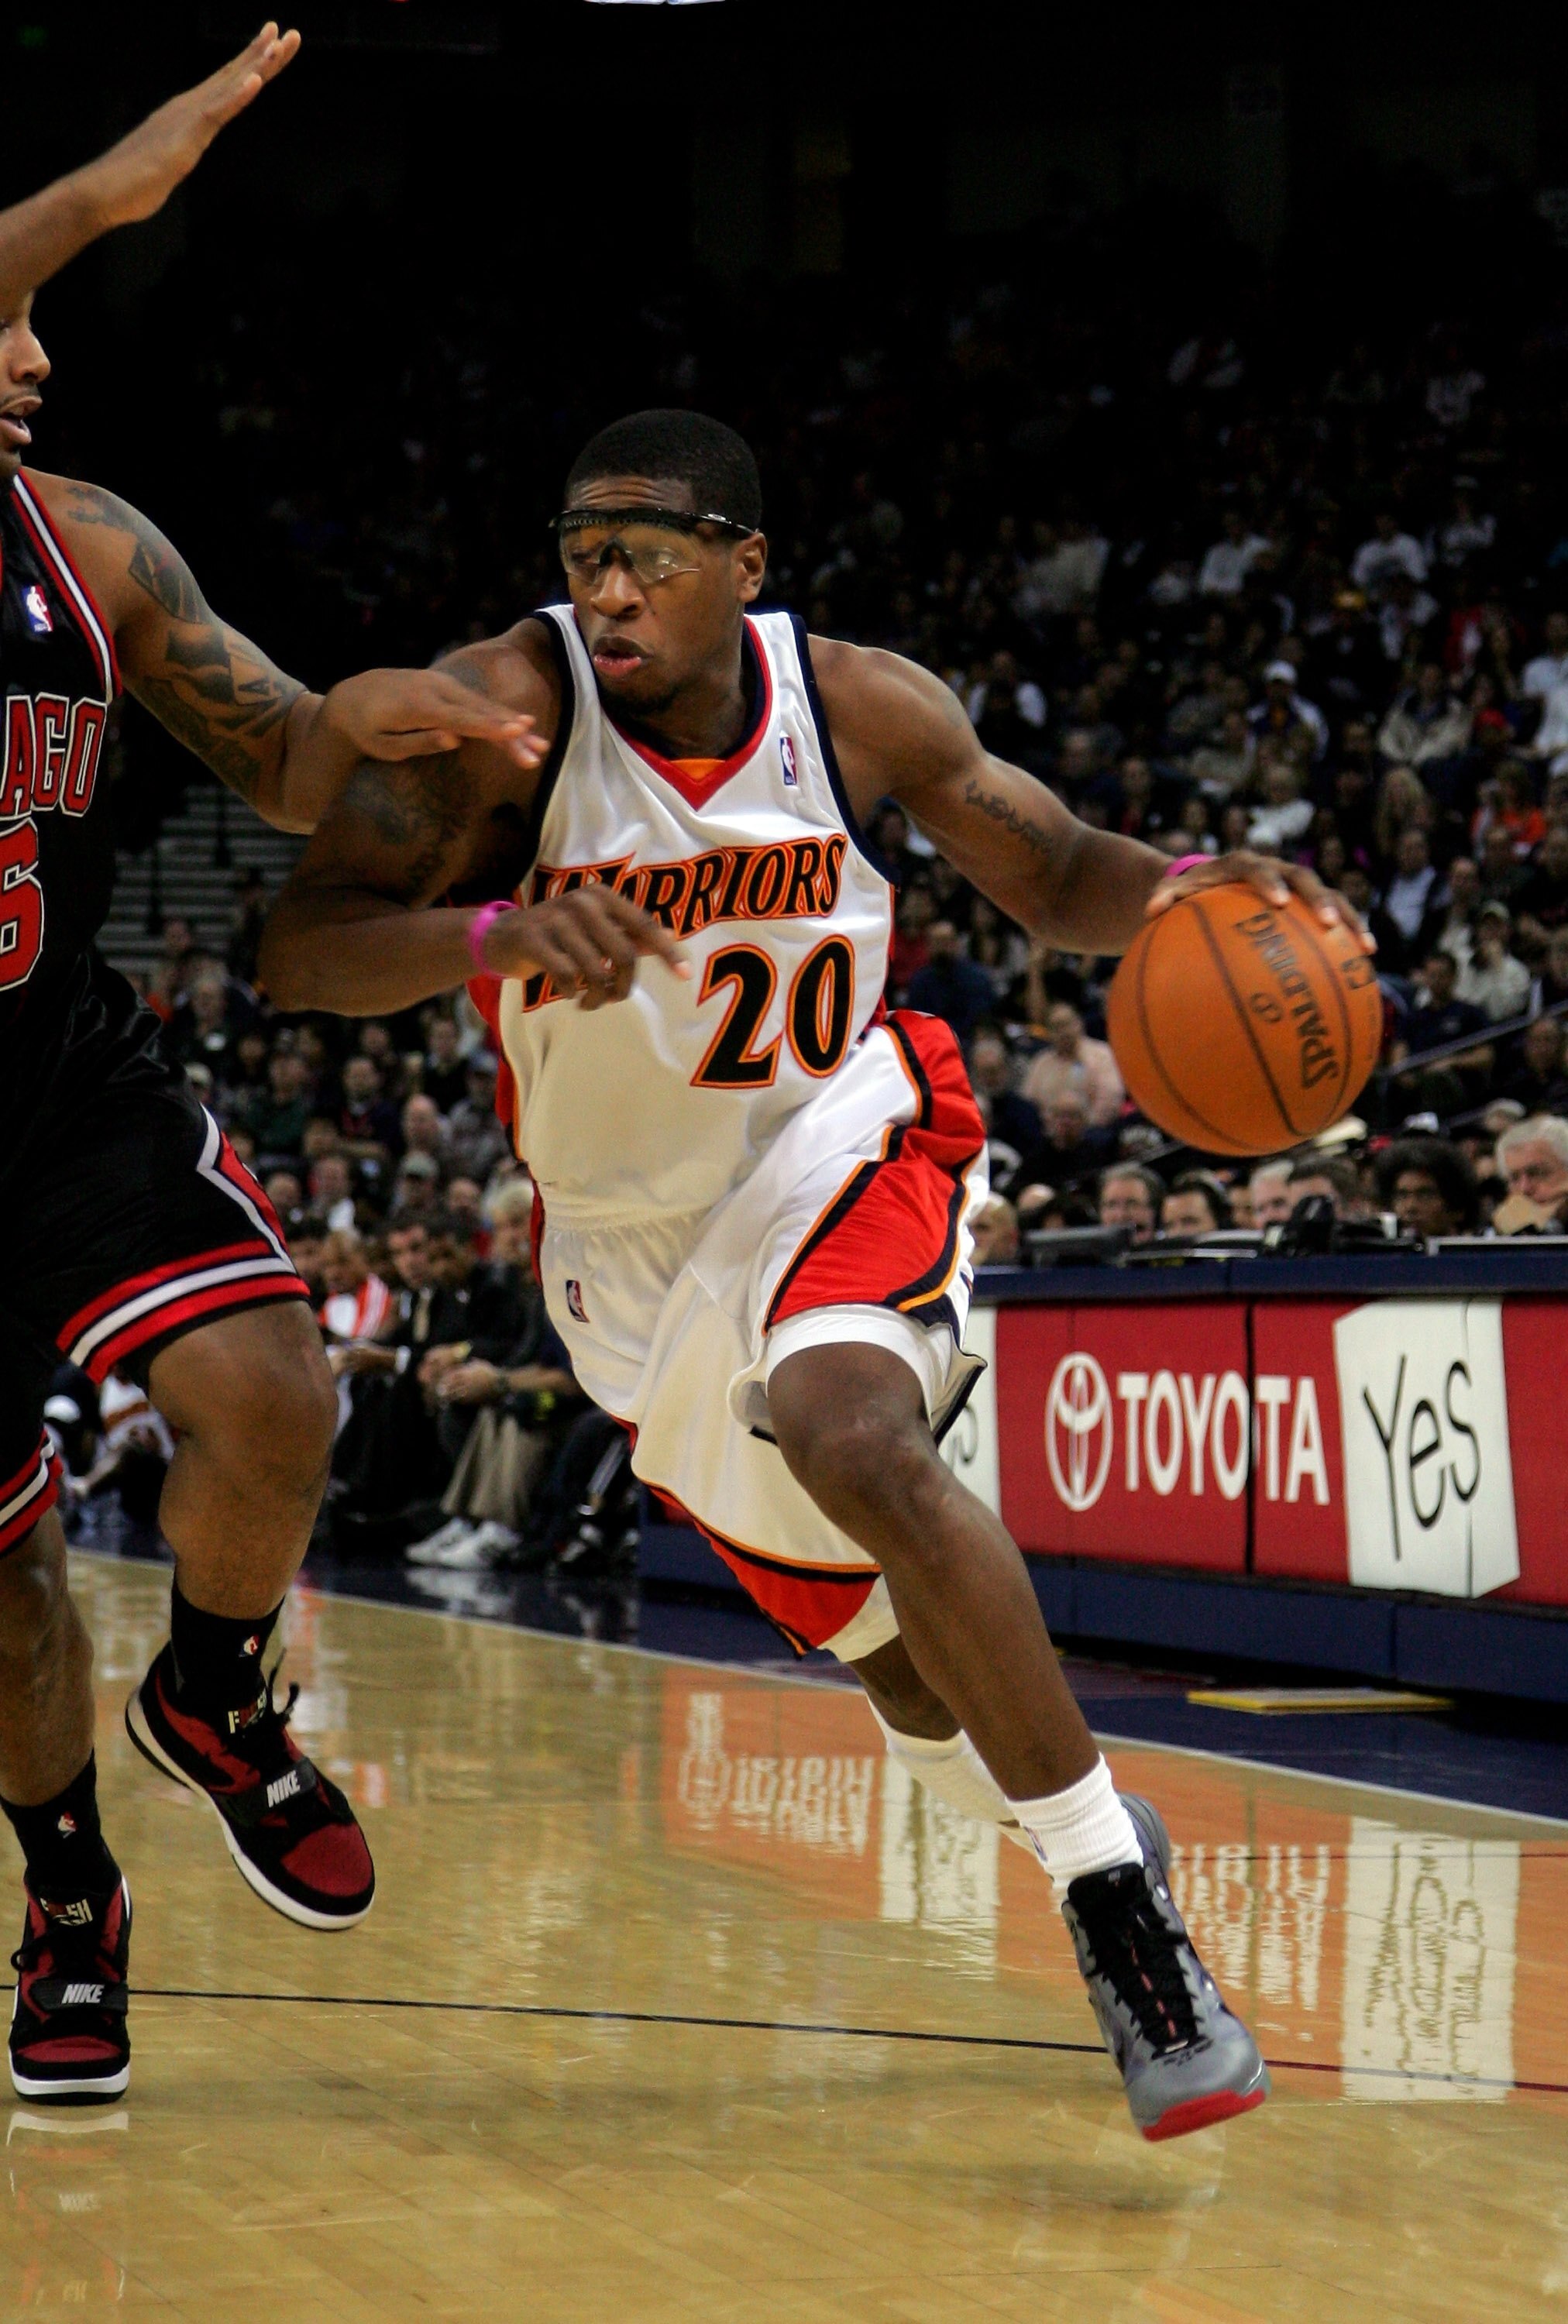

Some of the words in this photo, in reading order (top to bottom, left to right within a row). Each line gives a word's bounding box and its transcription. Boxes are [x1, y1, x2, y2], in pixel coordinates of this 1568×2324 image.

[0, 692, 107, 821] AGO
[689, 933, 855, 1089] 20
[1233, 908, 1339, 1090] SPALDING
[1117, 1369, 1330, 1507] TOYOTA
[1362, 1354, 1482, 1563] Yes
[266, 1769, 301, 1809] NIKE
[60, 1983, 105, 2004] NIKE
